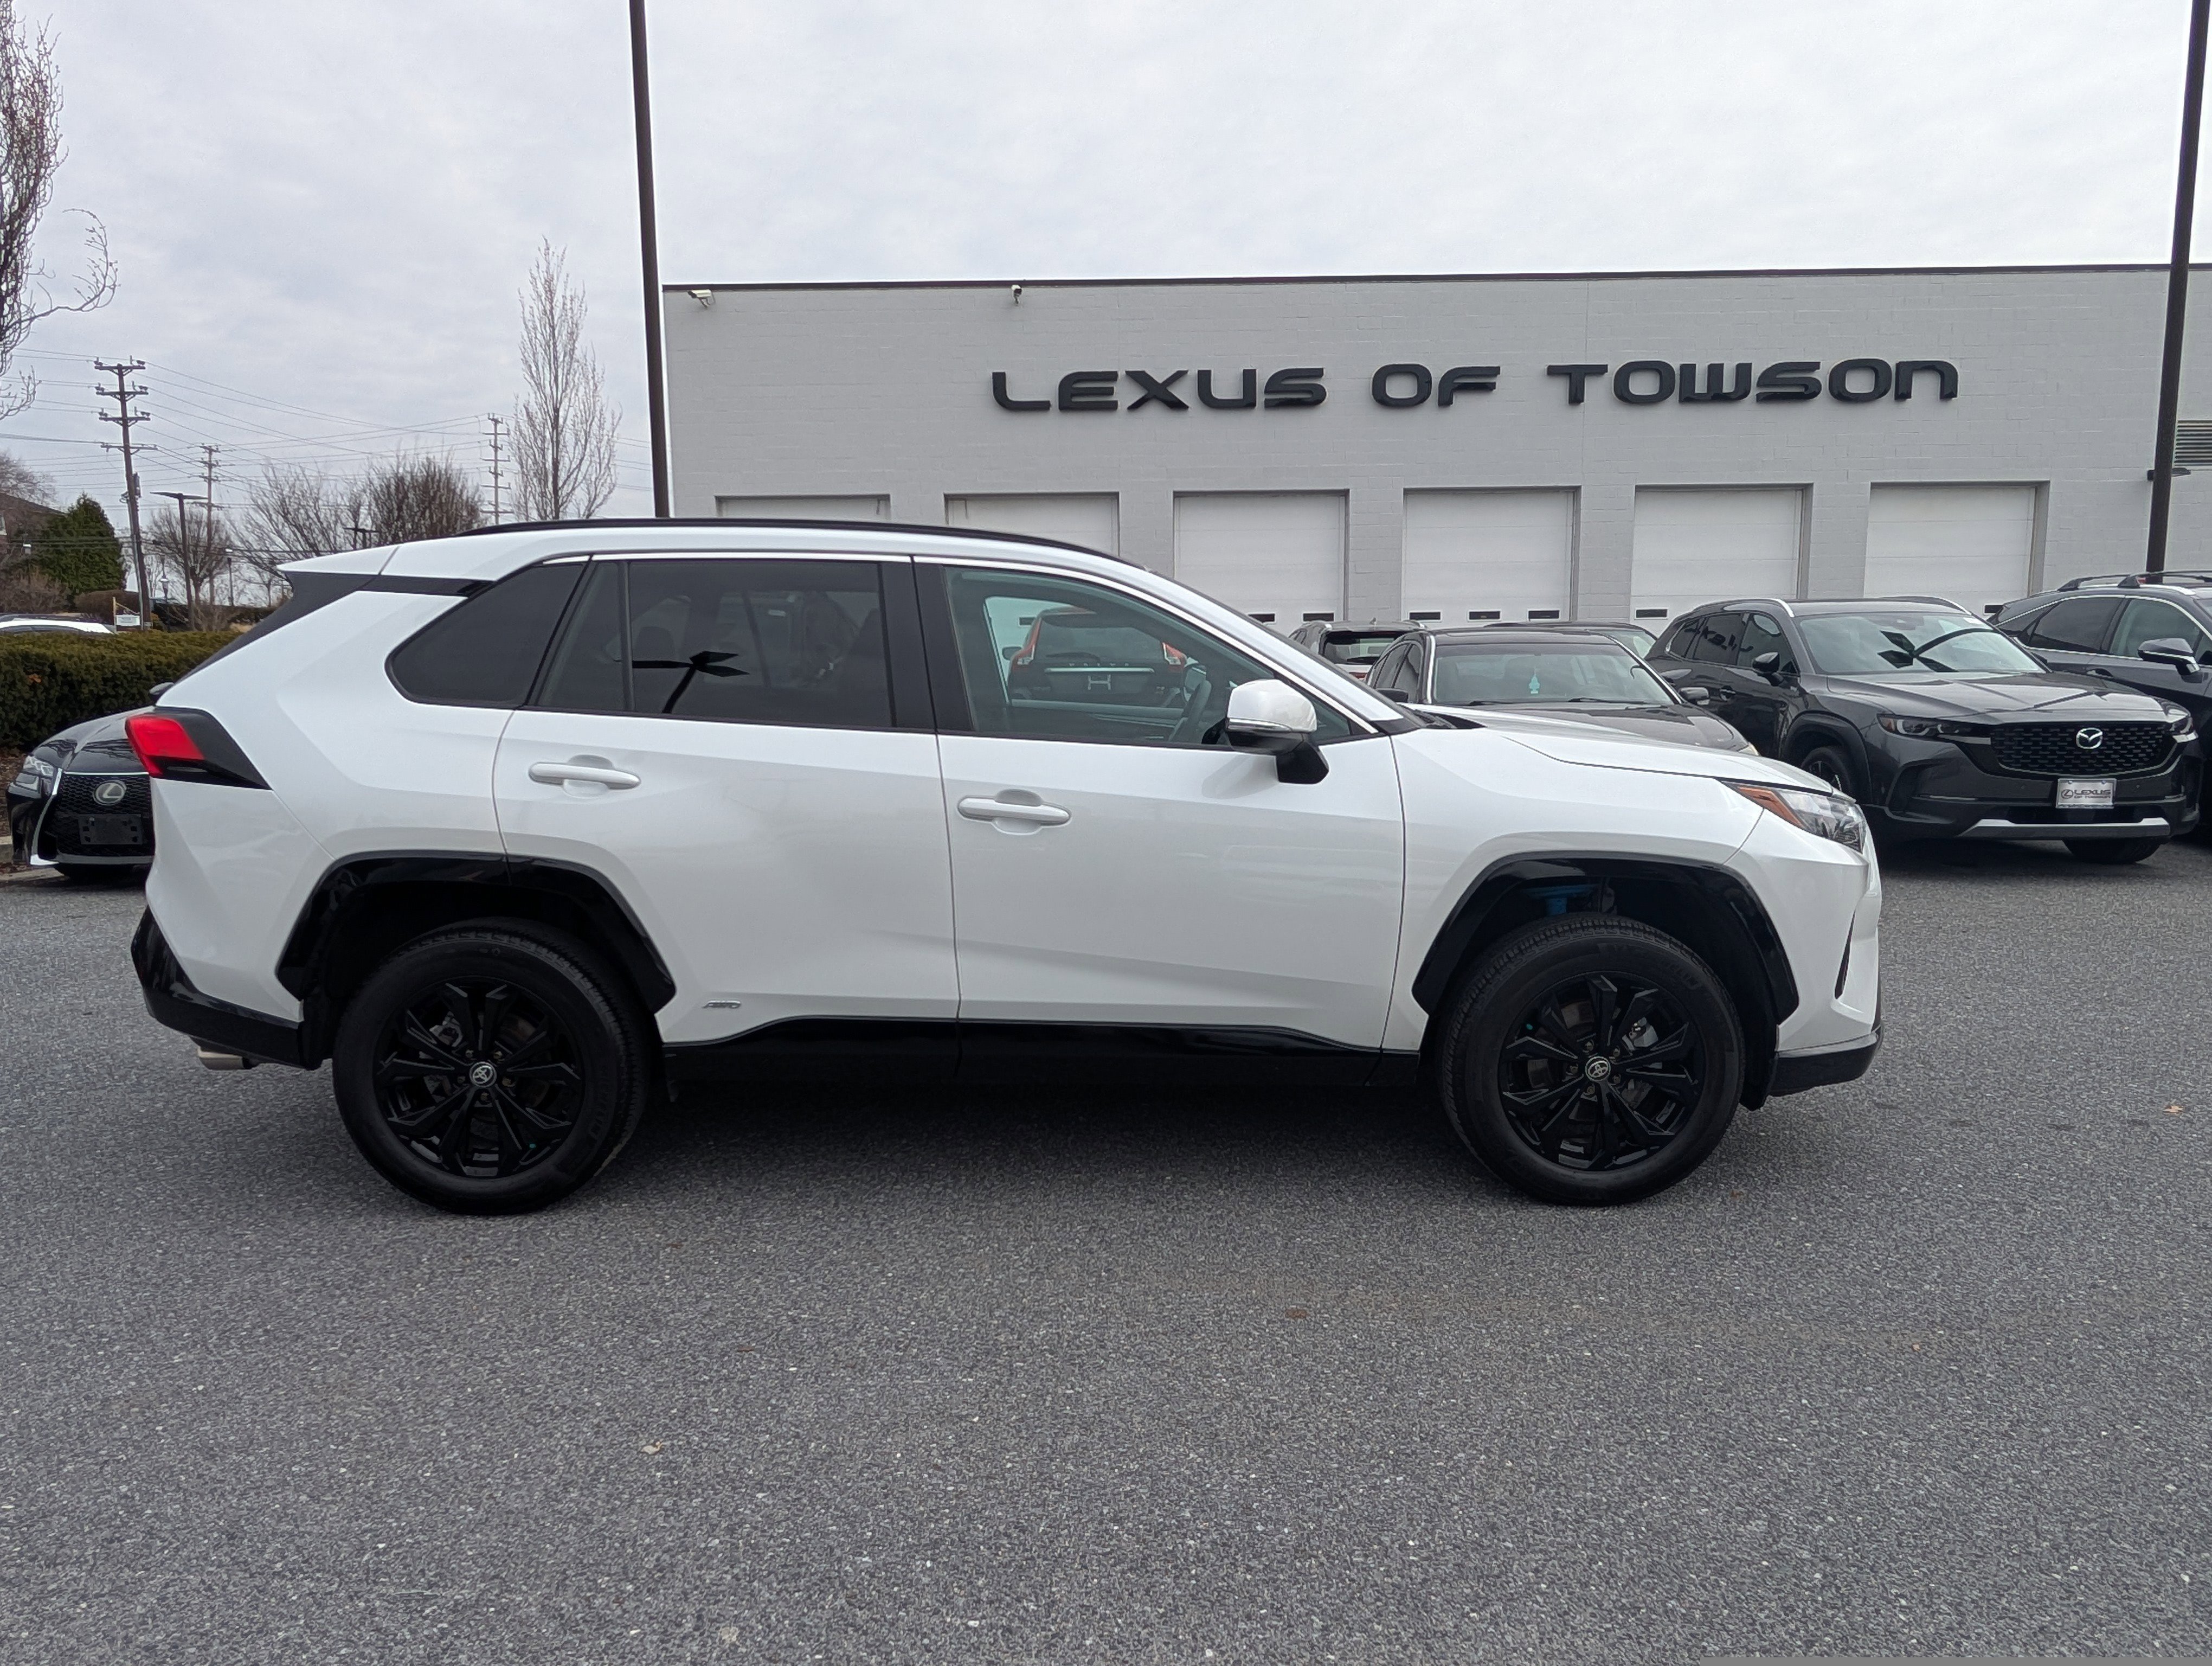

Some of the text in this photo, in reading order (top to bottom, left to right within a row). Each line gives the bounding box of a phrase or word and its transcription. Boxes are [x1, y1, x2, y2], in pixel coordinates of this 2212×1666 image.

[992, 358, 1959, 412] LEXUS OF TOWSON
